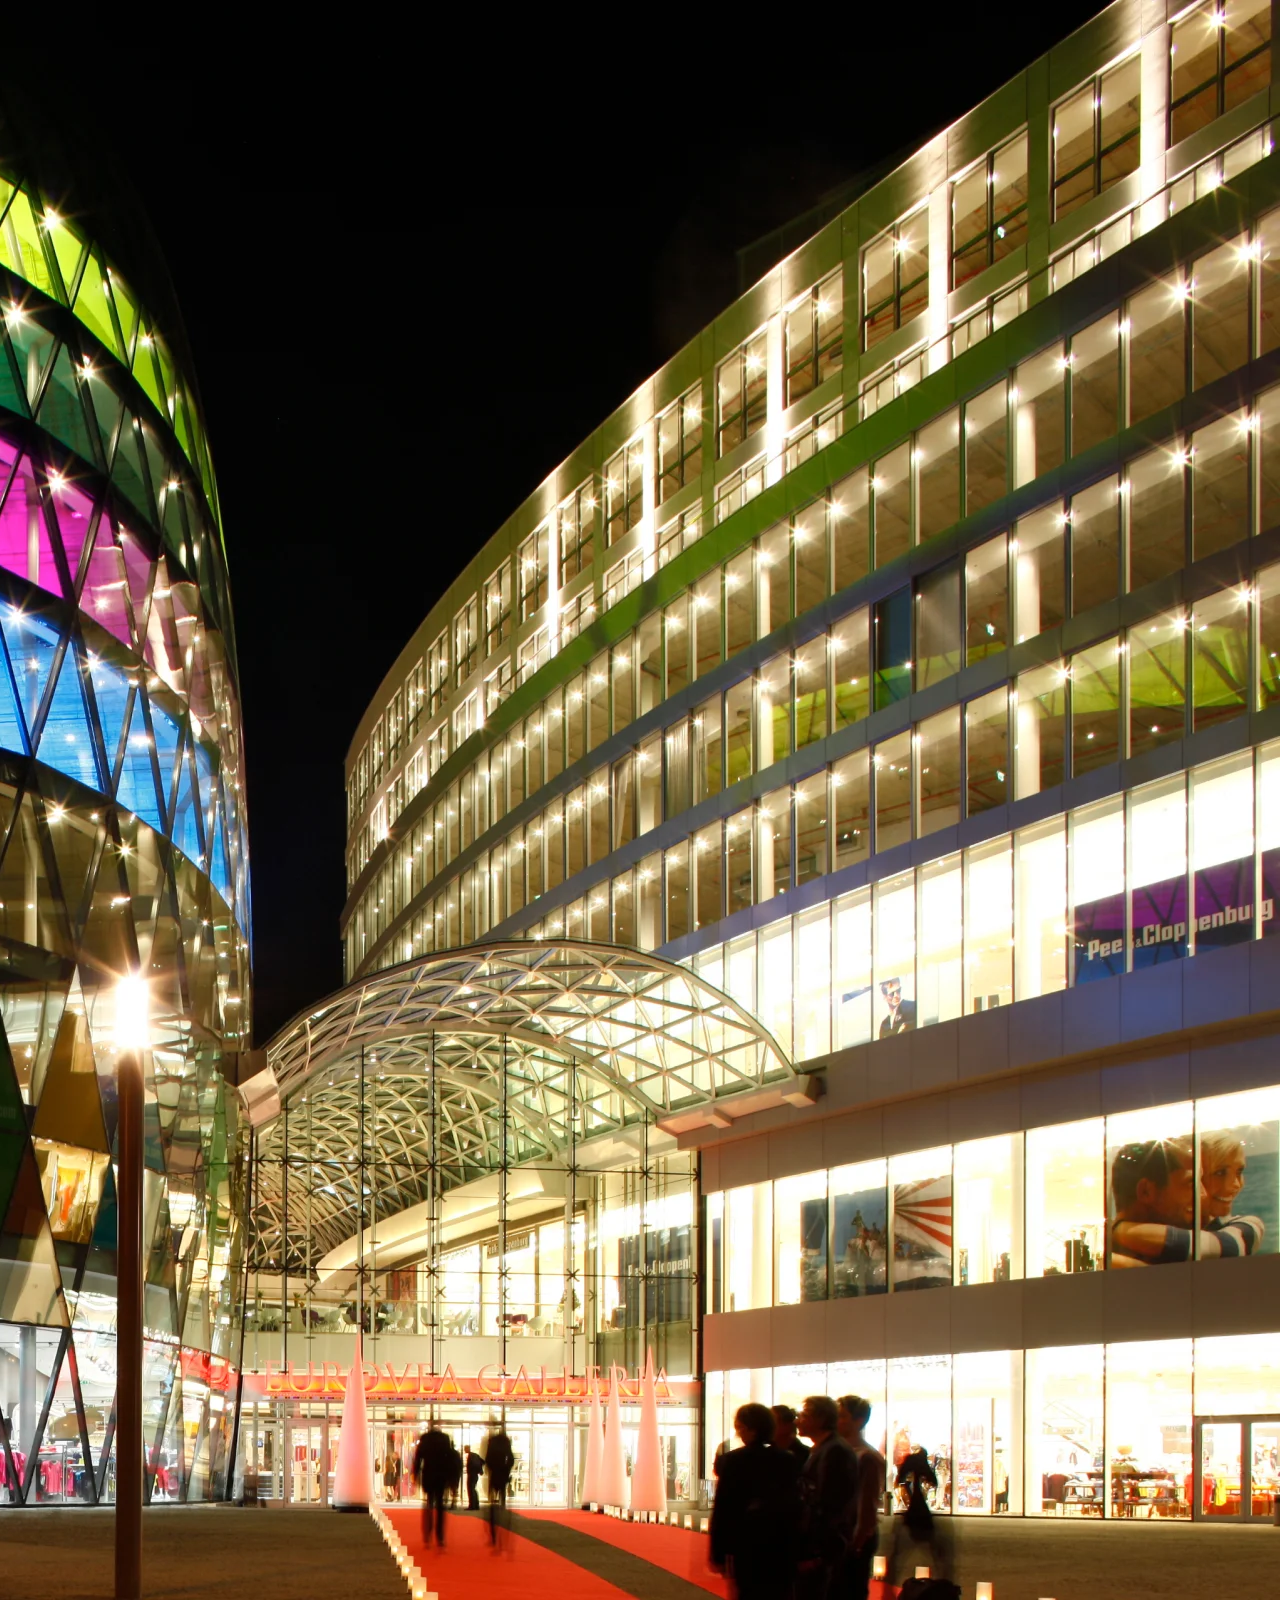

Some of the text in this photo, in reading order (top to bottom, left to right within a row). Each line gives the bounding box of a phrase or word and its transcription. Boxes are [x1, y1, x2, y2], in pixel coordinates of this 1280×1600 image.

[1088, 935, 1133, 961] Pee
[1143, 898, 1274, 946] Clopenbug
[477, 1363, 675, 1397] GALLERIA
